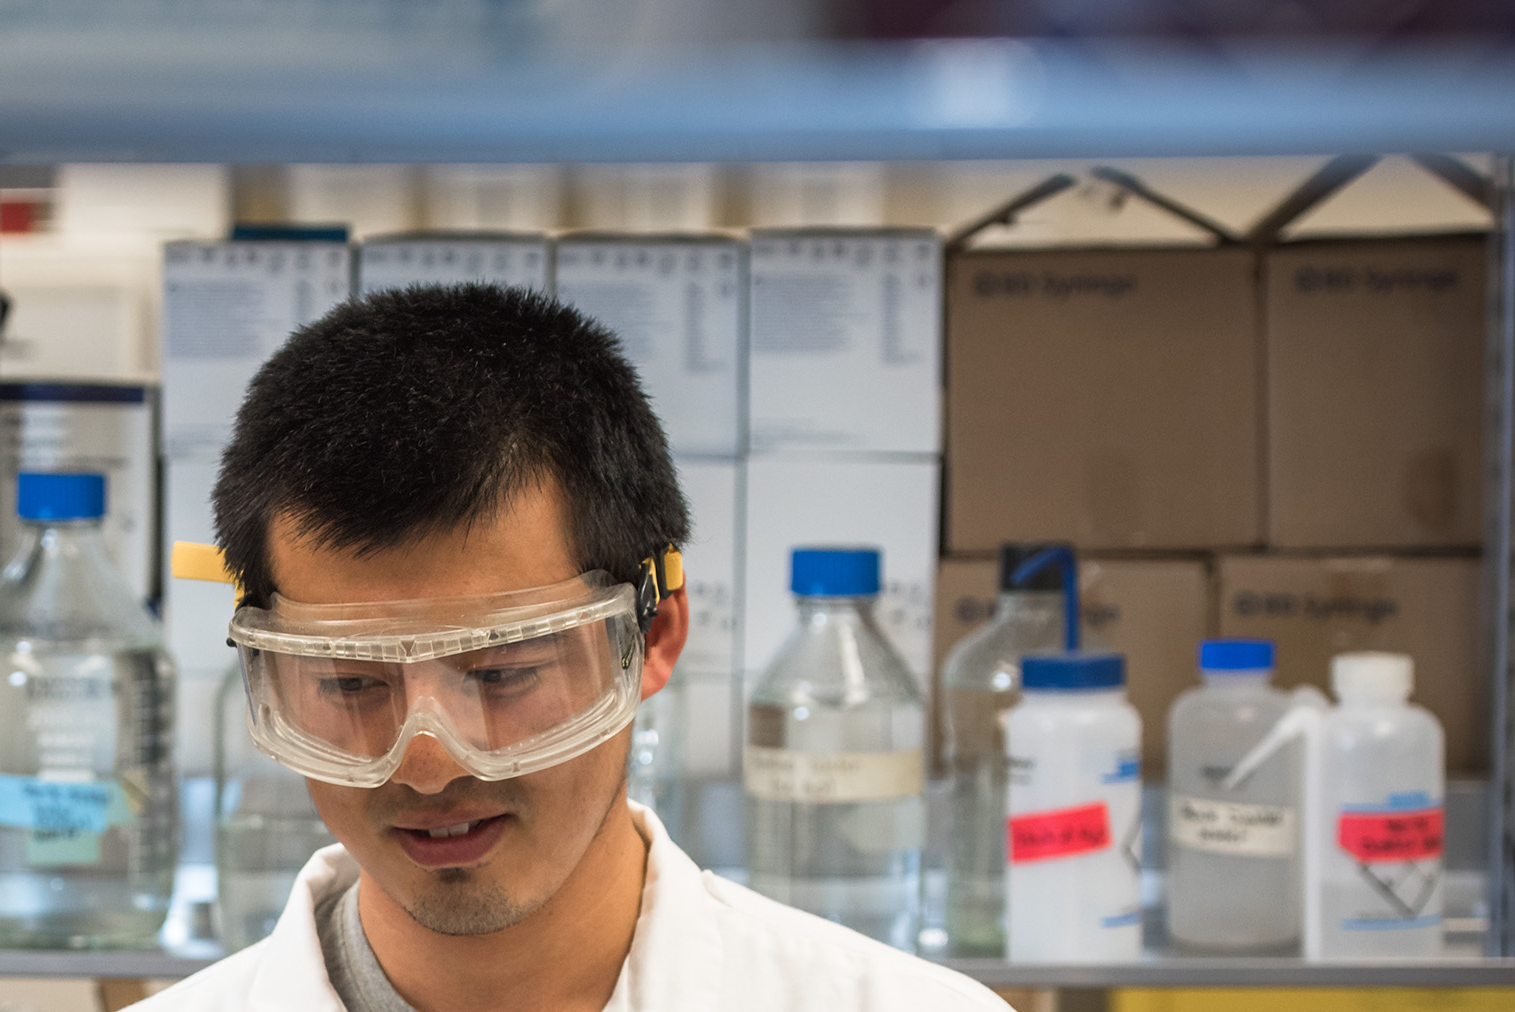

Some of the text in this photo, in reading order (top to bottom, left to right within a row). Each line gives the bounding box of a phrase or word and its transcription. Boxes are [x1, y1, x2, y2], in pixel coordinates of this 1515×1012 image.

[1043, 272, 1136, 299] Syringe
[1367, 269, 1458, 295] Syringe
[1304, 593, 1398, 622] Syringe
